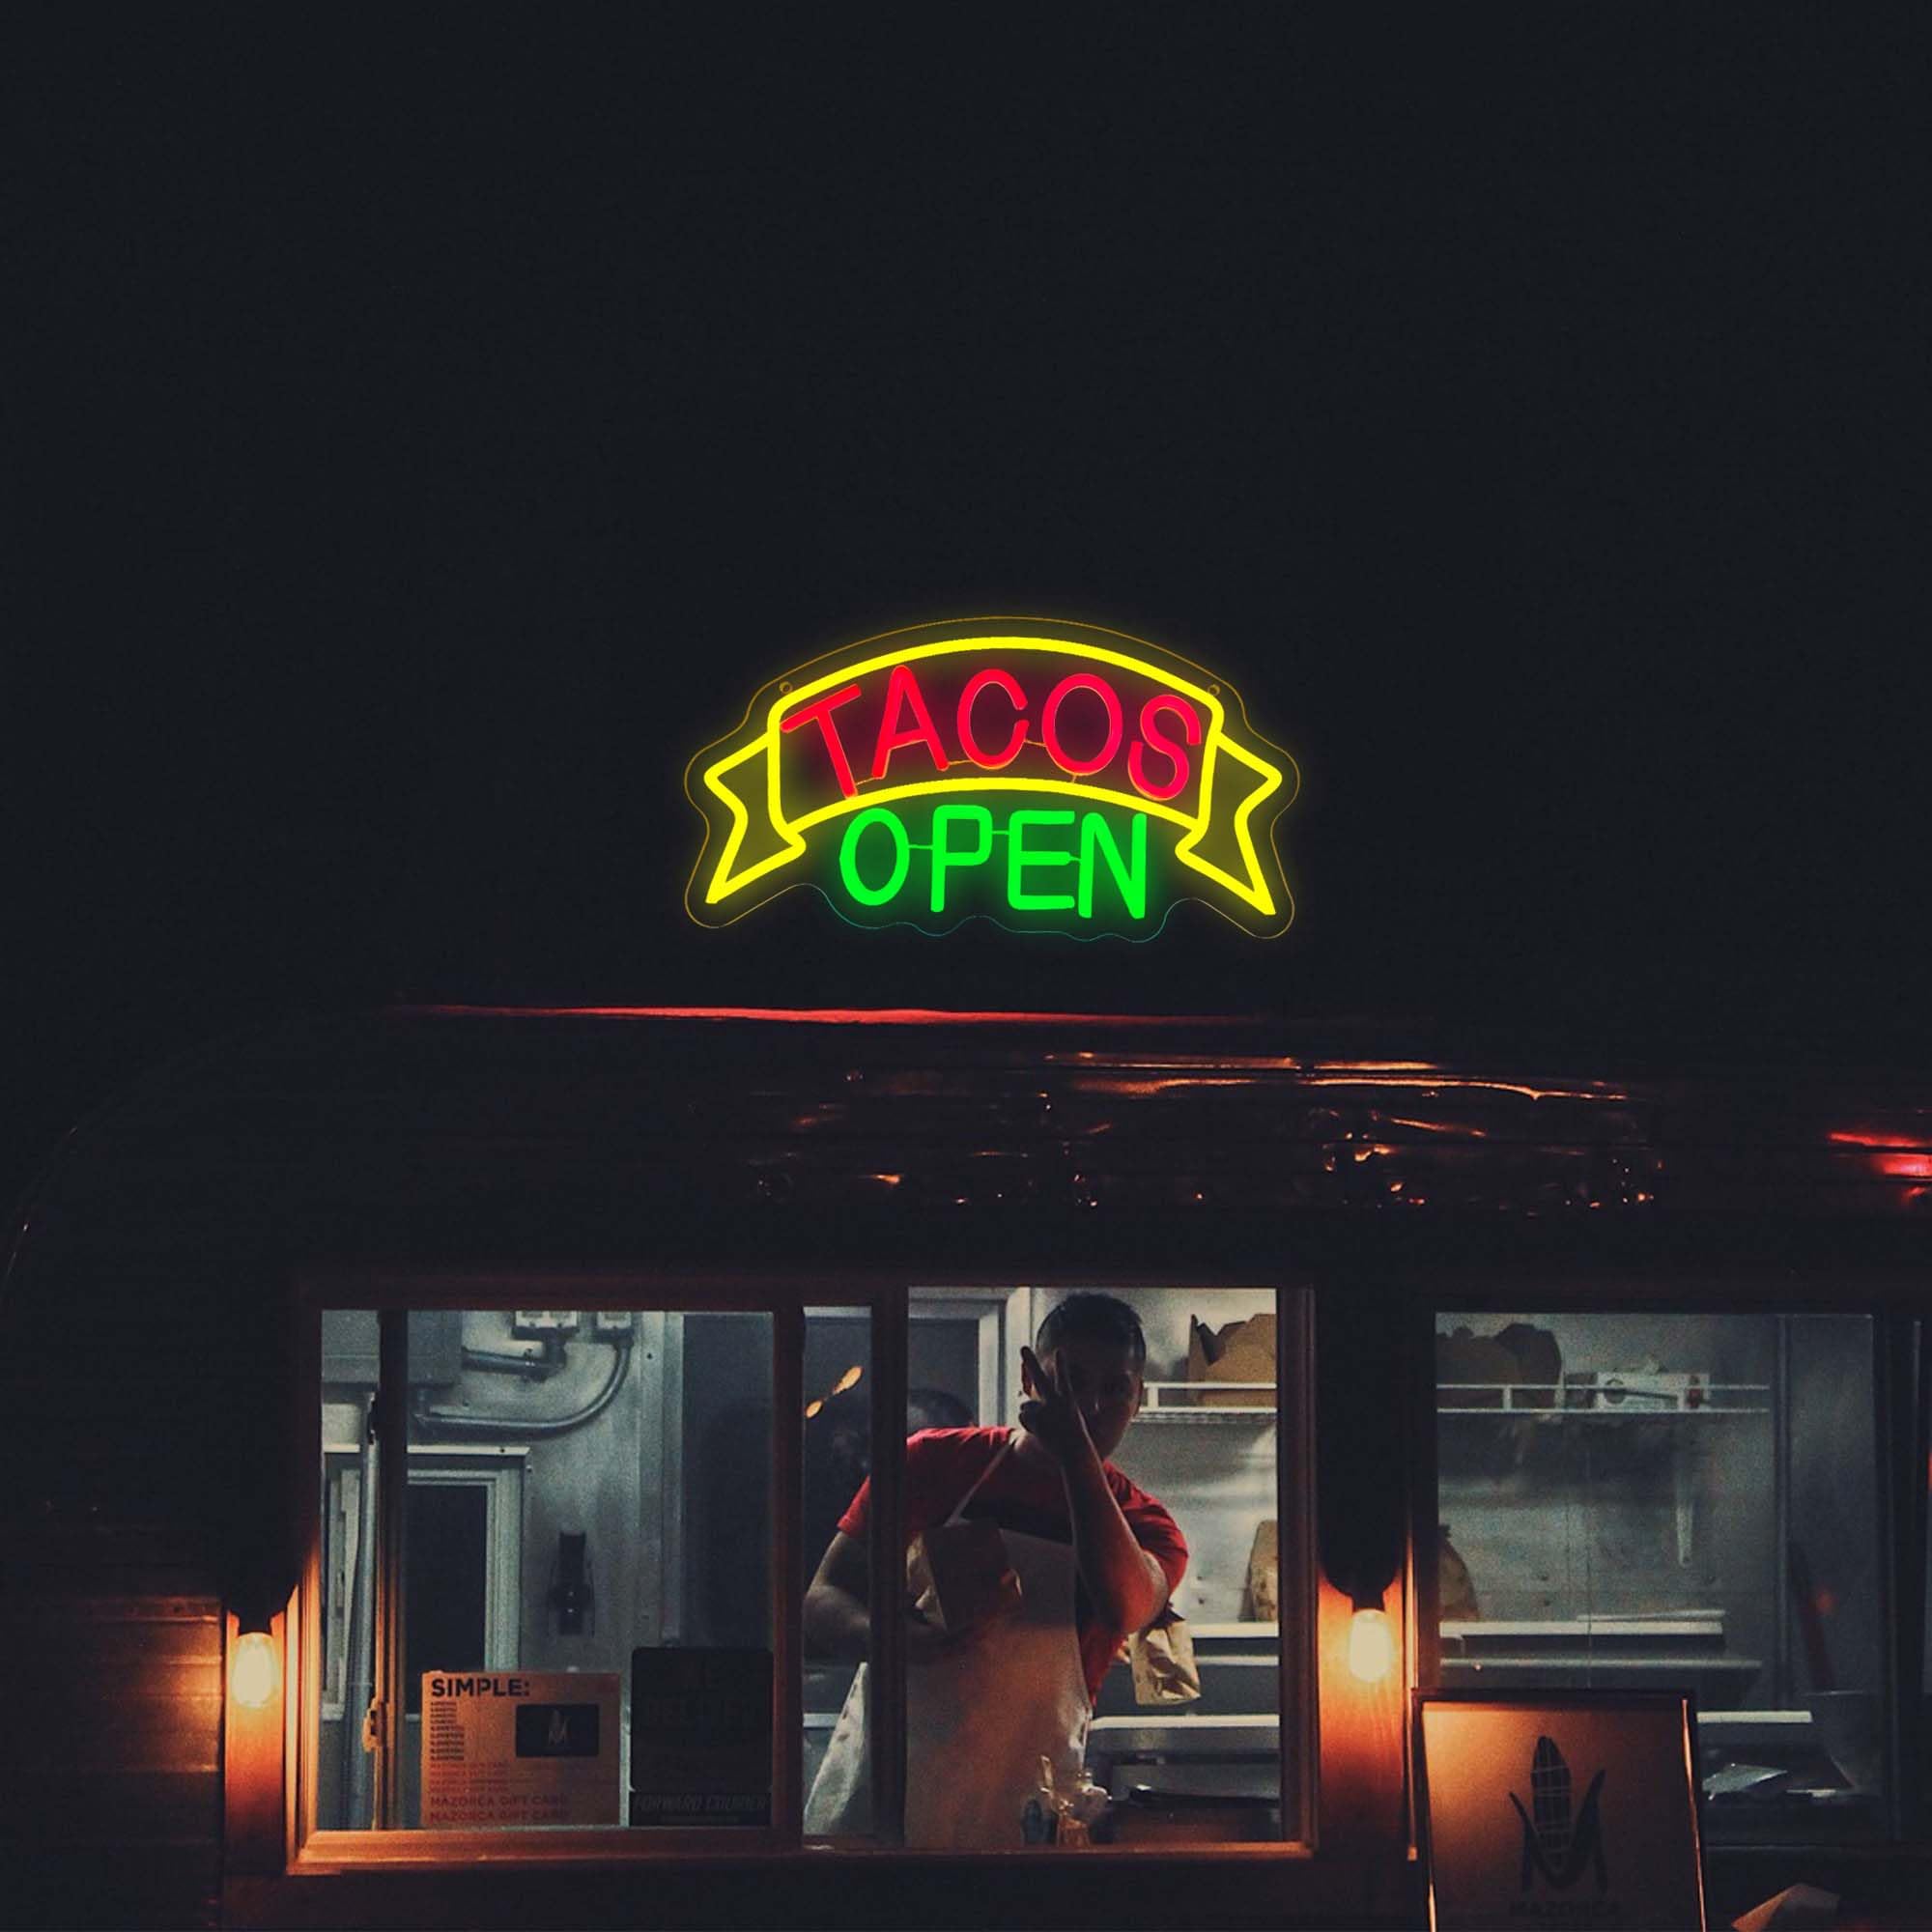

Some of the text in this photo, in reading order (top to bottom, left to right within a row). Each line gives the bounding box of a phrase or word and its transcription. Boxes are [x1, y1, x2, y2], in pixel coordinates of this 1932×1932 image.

[781, 665, 1202, 801] TACOS
[839, 805, 1148, 919] OPEN
[431, 1678, 530, 1697] SIMPLE:
